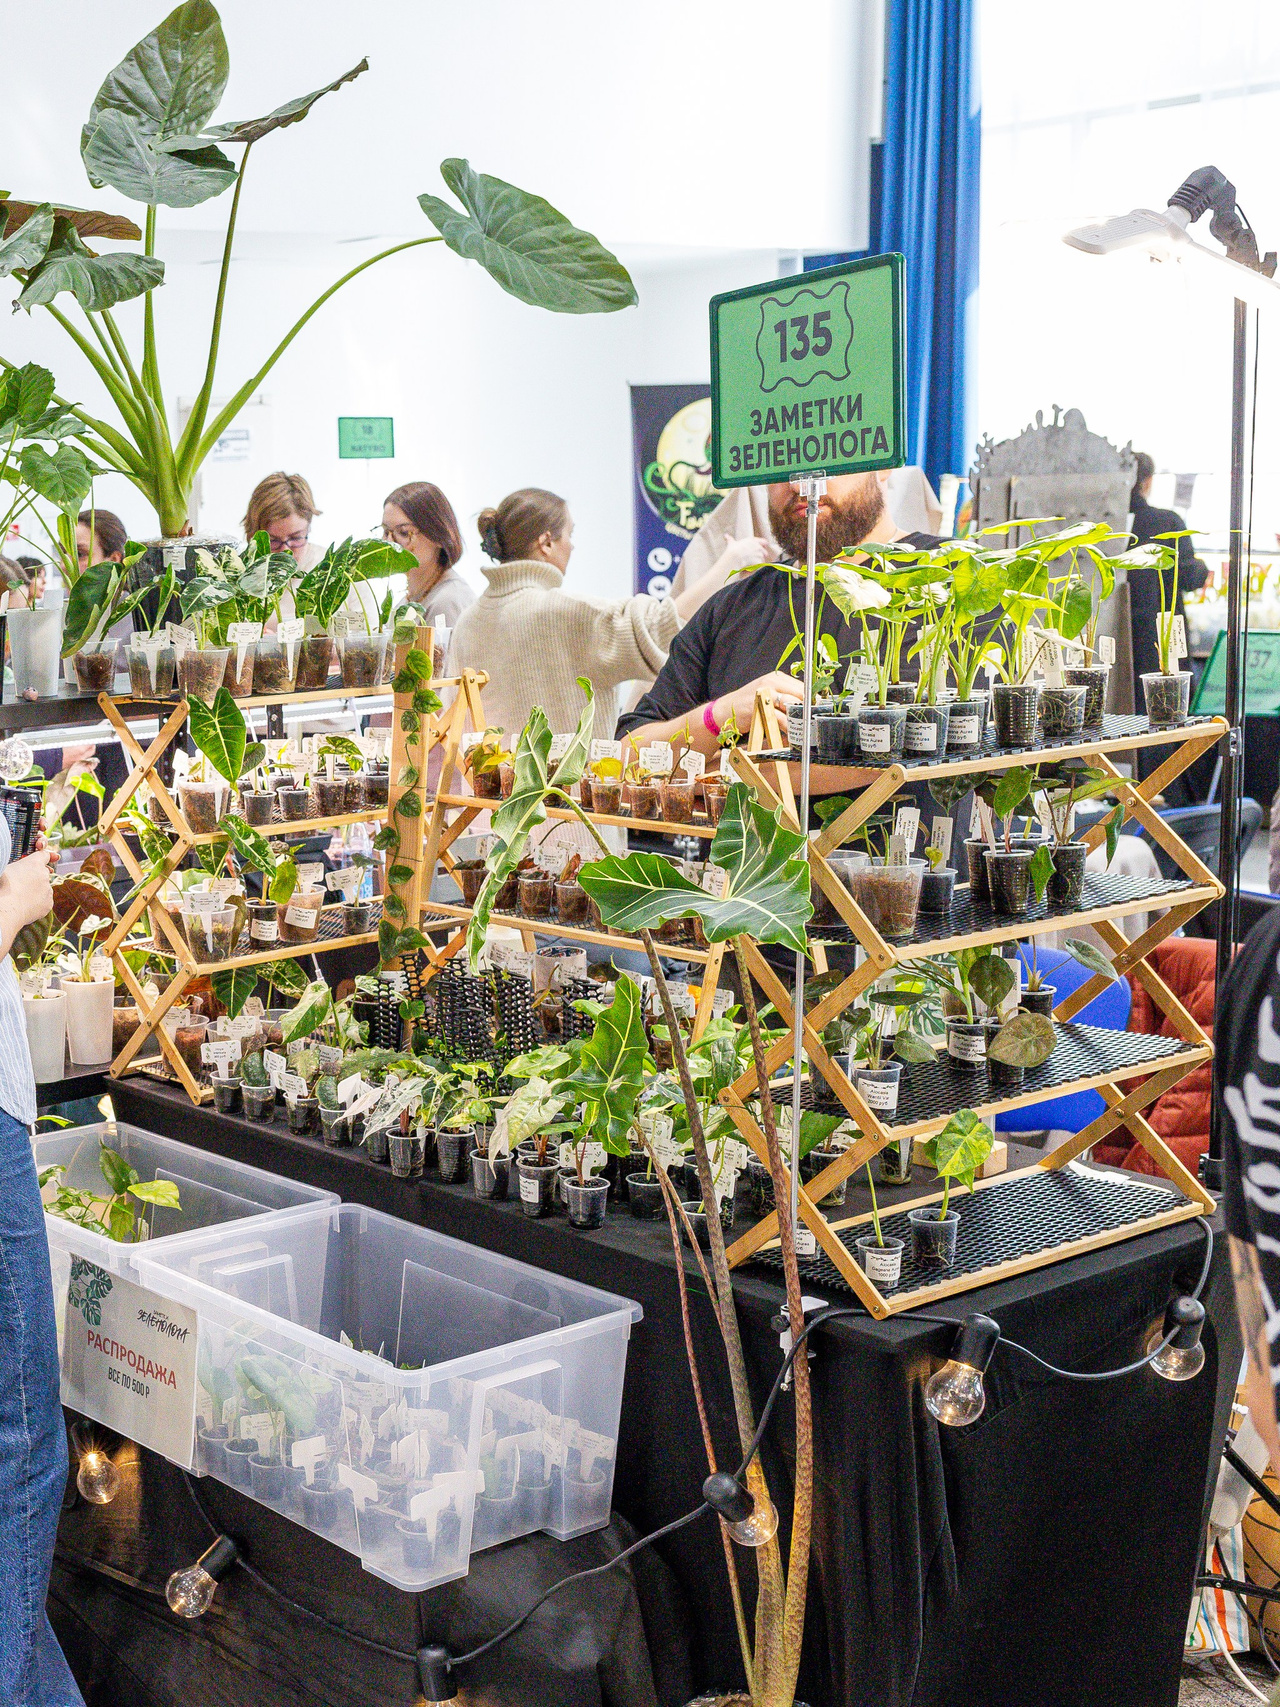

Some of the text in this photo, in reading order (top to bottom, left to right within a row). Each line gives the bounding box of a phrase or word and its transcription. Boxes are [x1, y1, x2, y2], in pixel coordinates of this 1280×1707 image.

[773, 310, 833, 363] 135
[749, 393, 863, 437] ЗАМЕТКИ
[729, 425, 890, 473] ЗЕЛЕНОЛОГА
[87, 1329, 177, 1390] РАСПРОДАЖА
[108, 1367, 121, 1384] ВСЕ
[121, 1373, 131, 1389] ПО
[131, 1379, 144, 1397] 500
